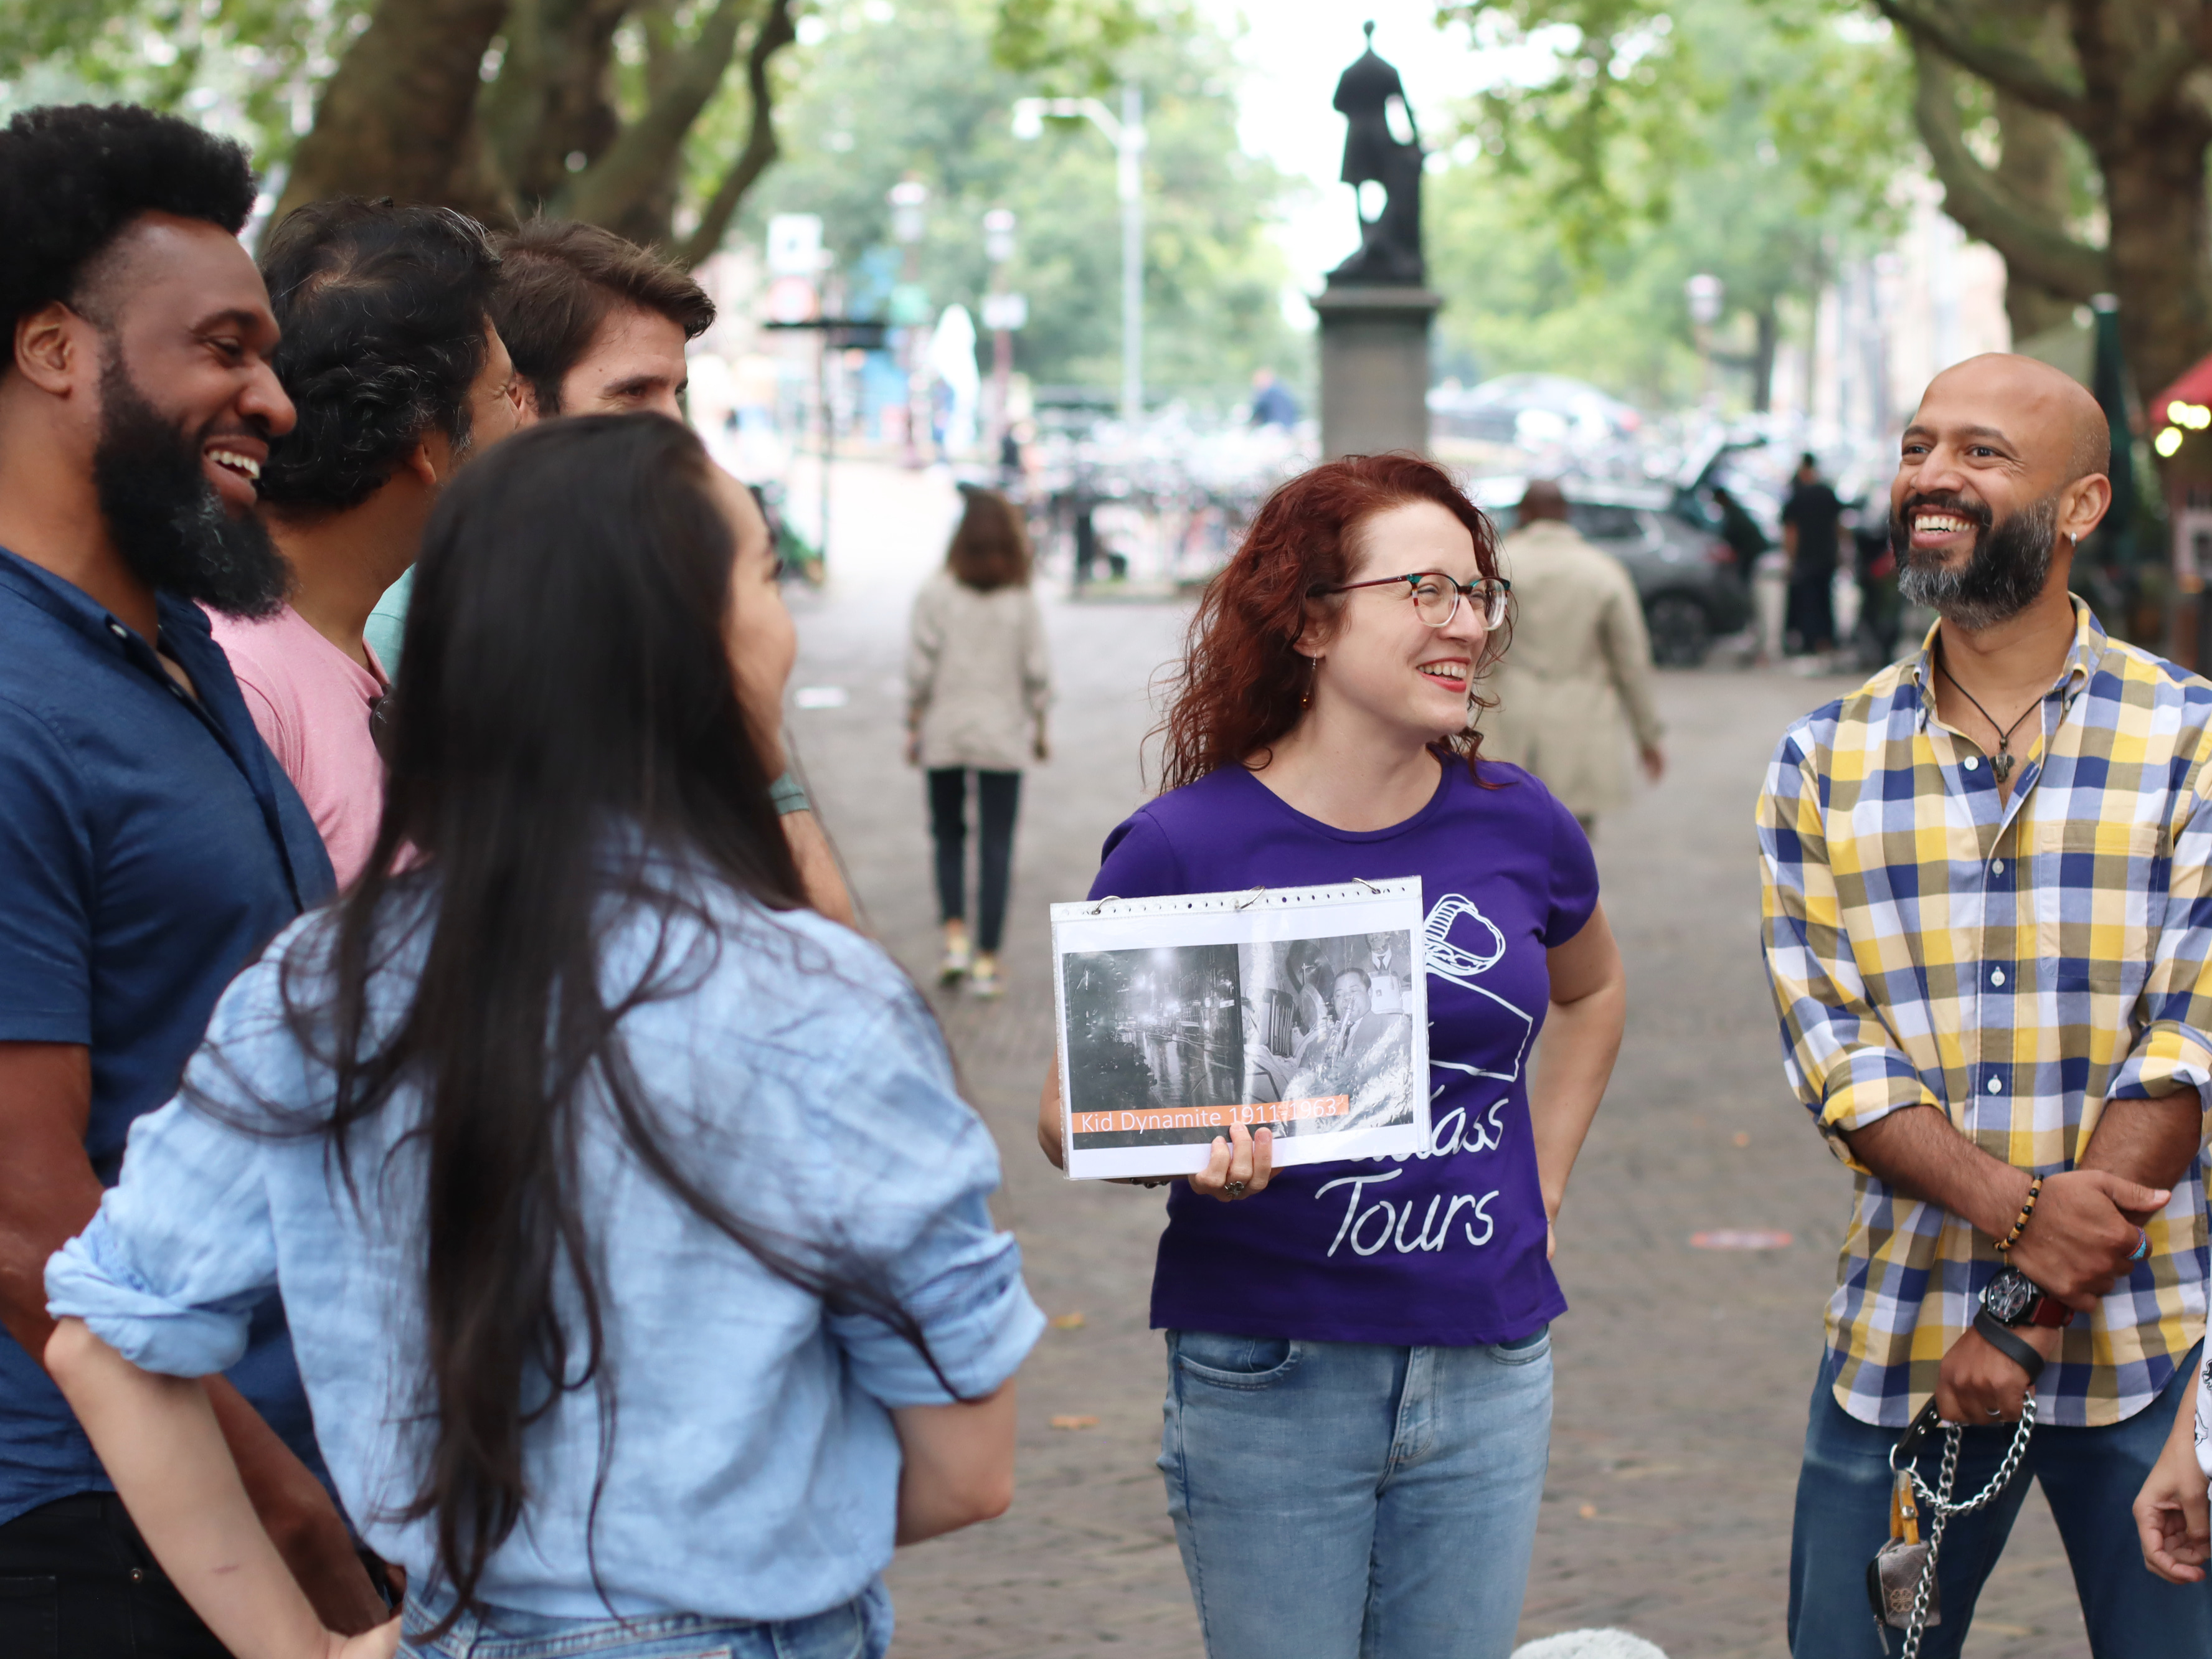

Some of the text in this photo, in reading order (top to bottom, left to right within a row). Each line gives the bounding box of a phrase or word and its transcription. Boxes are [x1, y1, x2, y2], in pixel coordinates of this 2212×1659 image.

[1082, 1098, 1337, 1134] Kid Dynamite 1911-1963
[1315, 1168, 1500, 1257] Tours
